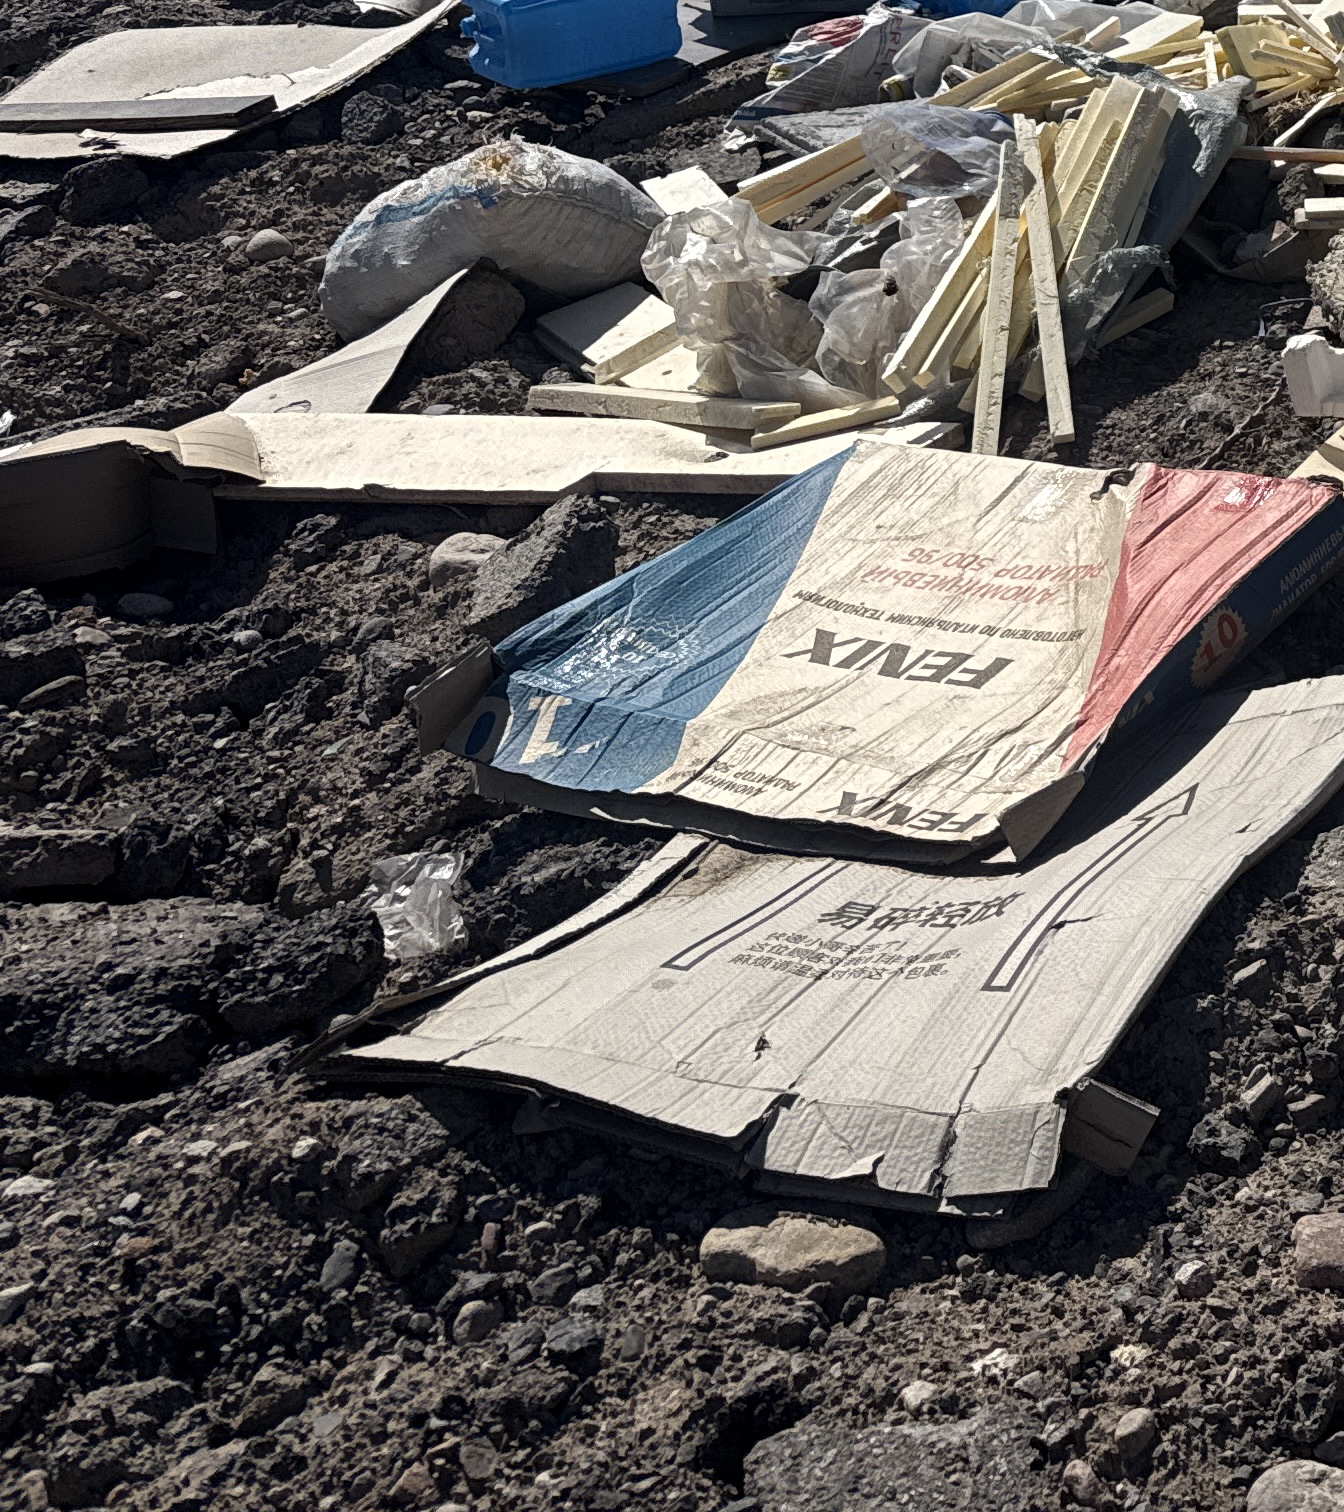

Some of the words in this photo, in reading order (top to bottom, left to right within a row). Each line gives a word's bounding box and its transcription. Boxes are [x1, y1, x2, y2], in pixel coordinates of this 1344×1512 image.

[901, 547, 995, 572] 500/96
[860, 565, 1062, 605] АЛЮМИНИЕВЫЙ
[792, 589, 886, 621] ТЕХНОЛОГИЯМ
[885, 612, 981, 635] ИТАЛЬЯНСКИМ
[978, 624, 1002, 638] ПО
[1200, 613, 1239, 672] 10
[780, 628, 1015, 690] FENIX
[732, 769, 801, 792] РАДИАТОР
[816, 890, 1026, 932] 易碎轻放
